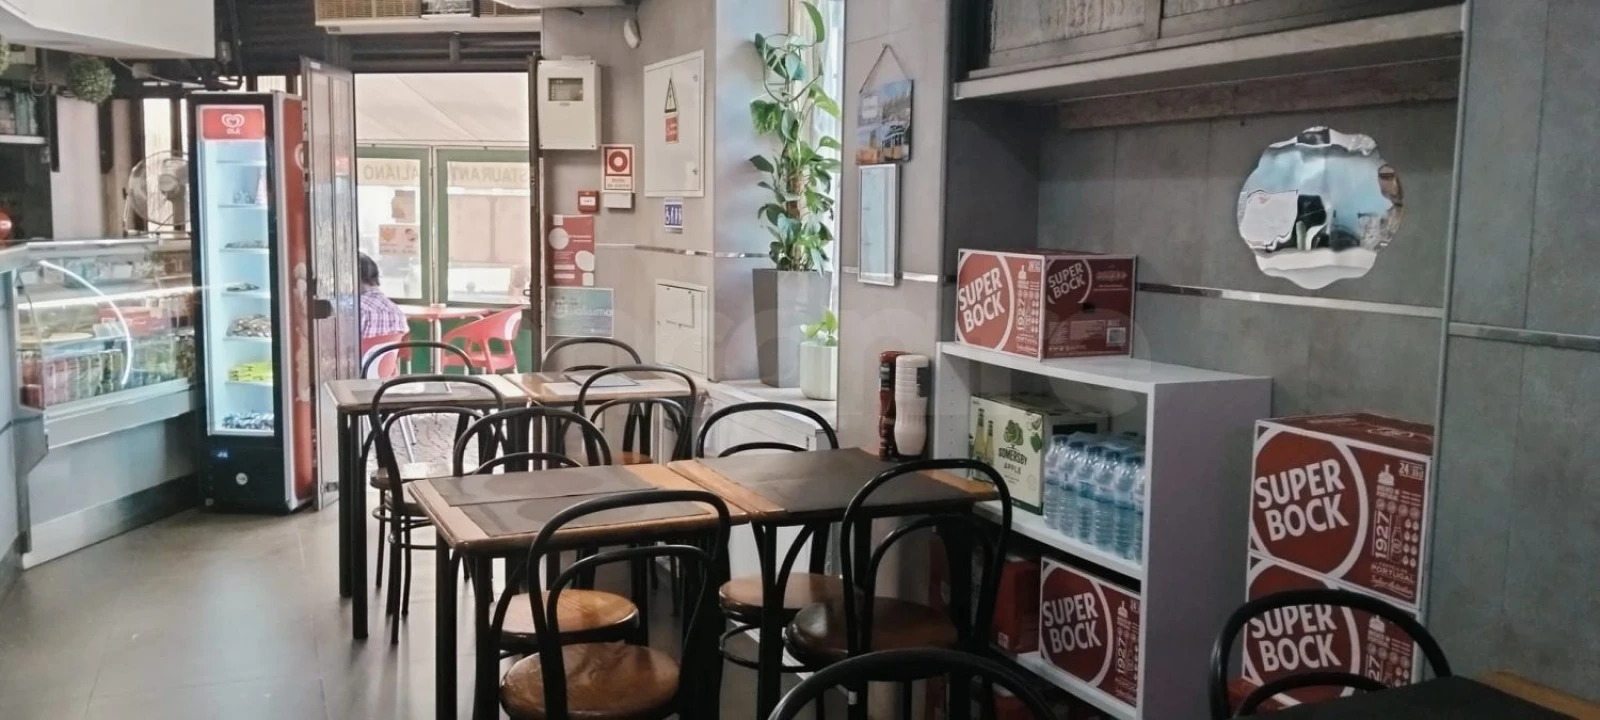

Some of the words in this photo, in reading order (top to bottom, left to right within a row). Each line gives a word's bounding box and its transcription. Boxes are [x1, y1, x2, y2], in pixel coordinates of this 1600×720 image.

[958, 267, 1003, 311] SUPER
[1047, 262, 1085, 289] SUPER
[1052, 273, 1087, 300] BOCK
[963, 291, 1006, 334] BOCK
[1254, 458, 1346, 510] SUPER
[1264, 493, 1350, 543] BOCK
[1375, 511, 1389, 559] 1927
[1041, 591, 1099, 628] SUPER
[1250, 604, 1338, 639] SUPER
[1050, 619, 1102, 655] BOCK
[1258, 633, 1342, 673] BOCK
